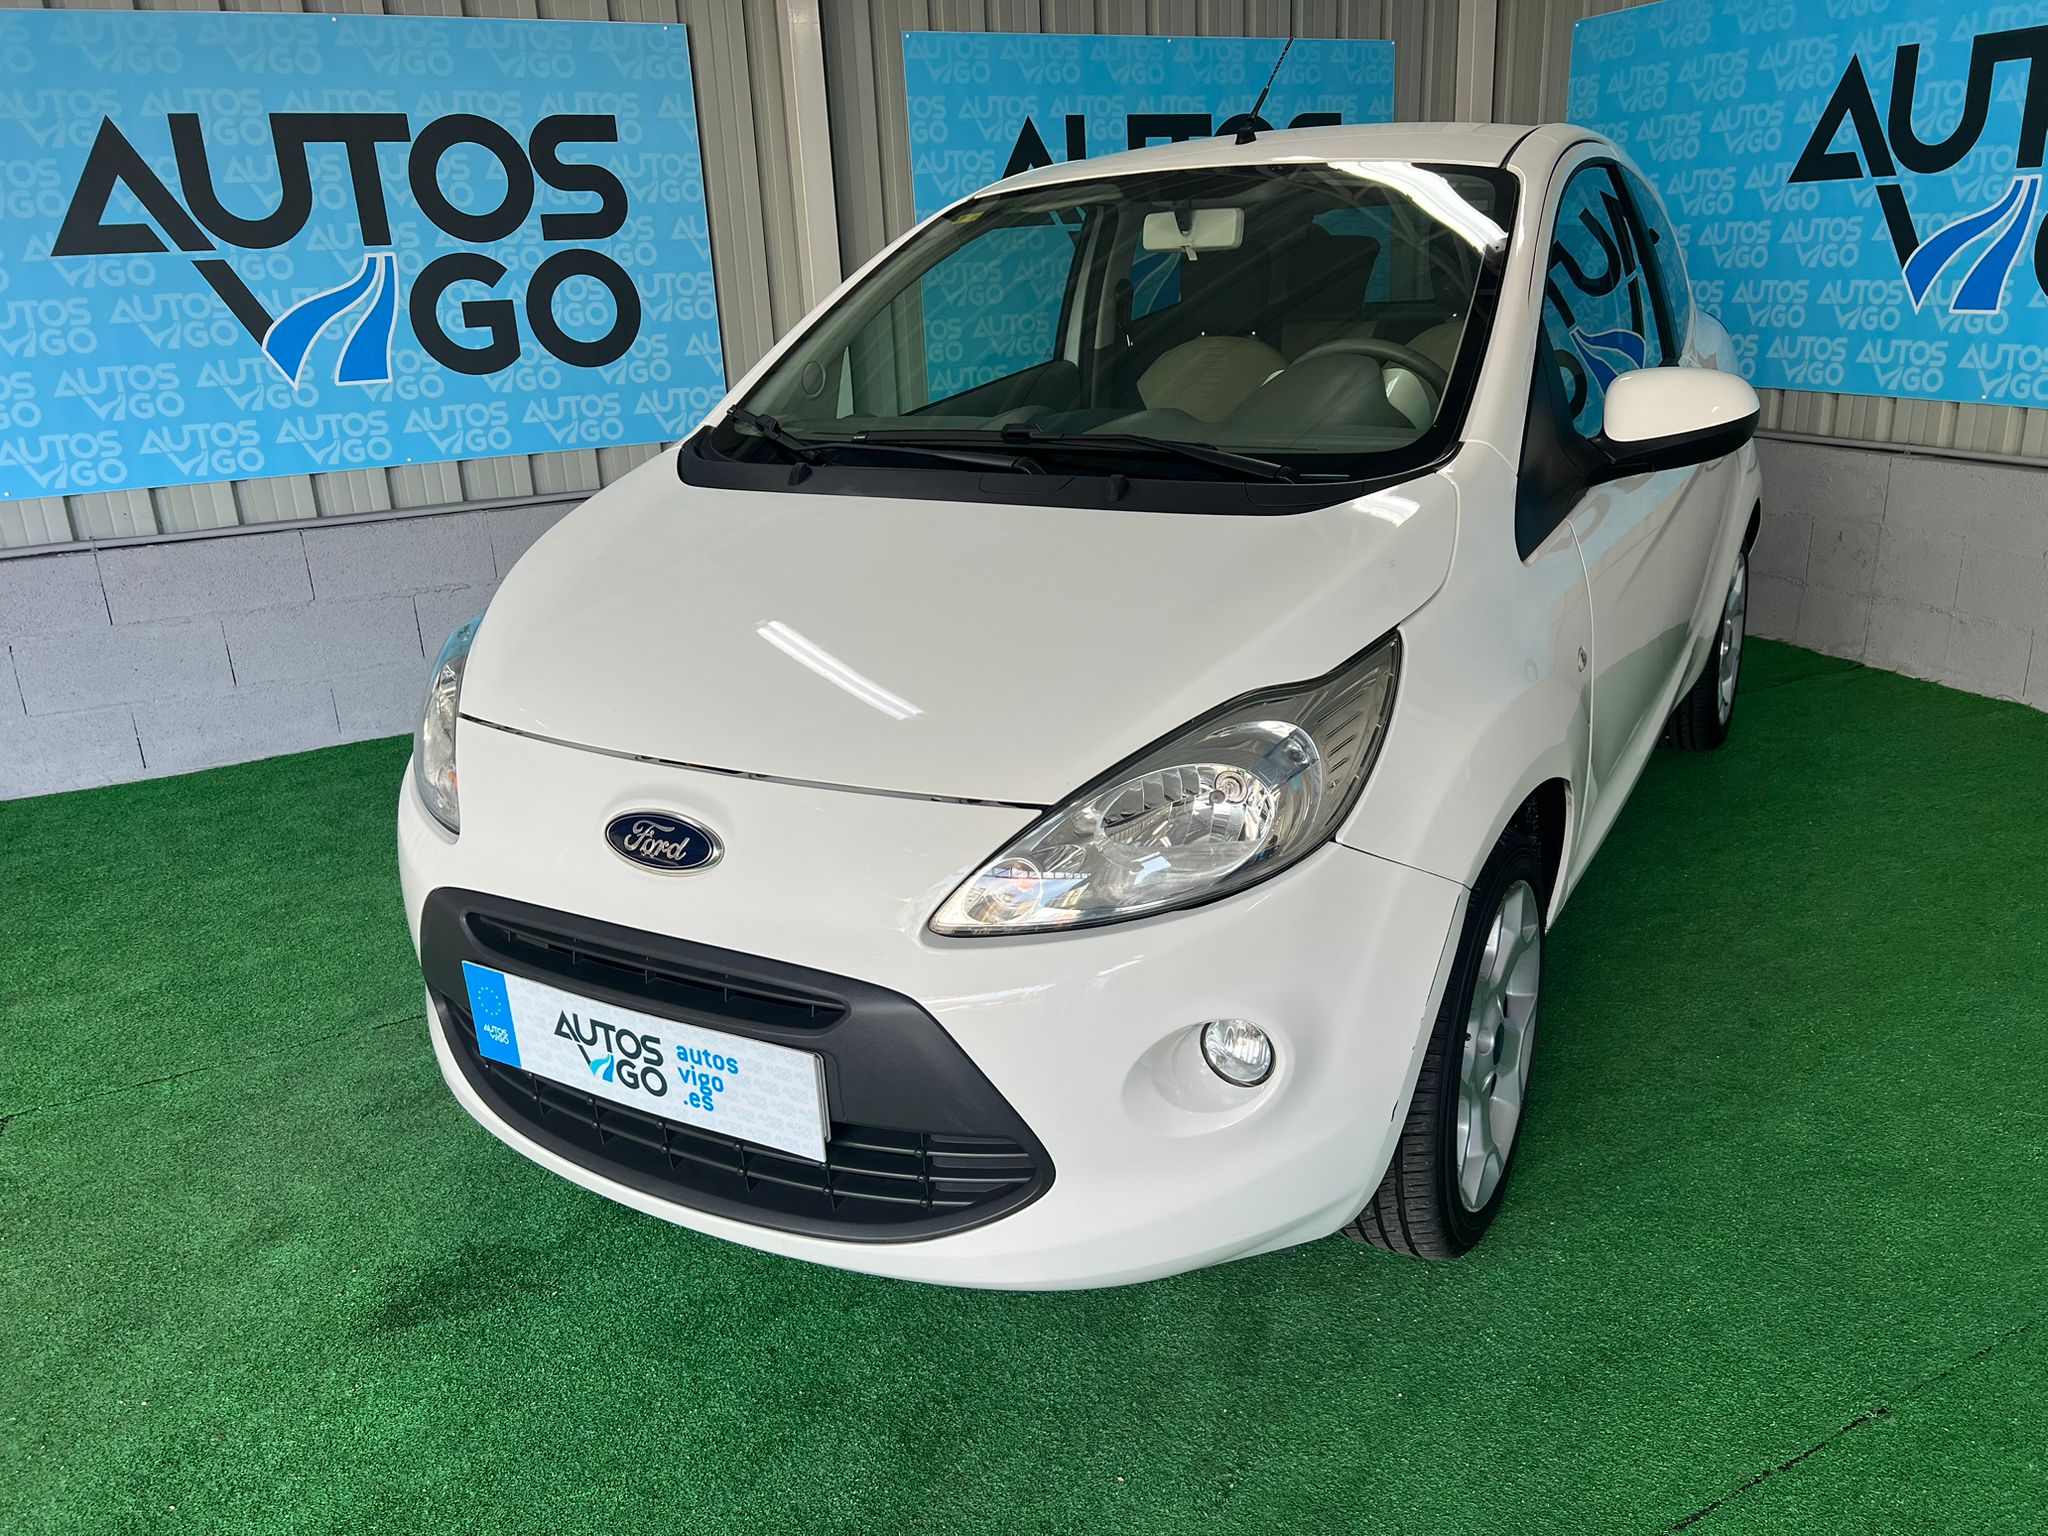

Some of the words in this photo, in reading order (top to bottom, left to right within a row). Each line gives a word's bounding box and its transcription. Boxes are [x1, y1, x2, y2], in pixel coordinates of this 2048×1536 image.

[49, 15, 178, 44] AUTOS
[197, 17, 320, 45] AUTOS
[335, 20, 449, 49] AUTOS
[465, 23, 572, 50] AUTOS
[587, 26, 684, 52] AUTOS
[77, 45, 183, 74] VIGO
[224, 46, 323, 75] VIGO
[362, 49, 454, 77] VIGO
[490, 50, 577, 79] VIGO
[606, 50, 689, 80] VIGO
[1676, 48, 1749, 84] AUTOS
[1756, 33, 1840, 71] AUTOS
[1606, 61, 1671, 95] AUTOS
[1690, 74, 1747, 104] VIGO
[1772, 60, 1836, 92] VIGO
[958, 95, 1041, 119] AUTOS
[1617, 87, 1669, 113] VIGO
[1636, 110, 1703, 142] AUTOS
[1710, 100, 1786, 134] AUTOS
[1648, 135, 1701, 162] VIGO
[1723, 126, 1783, 155] VIGO
[914, 151, 998, 175] AUTOS
[50, 112, 629, 257] AUTOS
[1665, 166, 1737, 196] AUTOS
[1680, 190, 1735, 217] VIGO
[1758, 185, 1822, 213] VIGO
[1697, 219, 1773, 246] AUTOS
[1779, 215, 1865, 244] AUTOS
[1711, 244, 1769, 269] VIGO
[1795, 243, 1860, 269] VIGO
[638, 272, 714, 300] UTOS
[1731, 278, 1810, 305] AUTOS
[1816, 279, 1904, 305] AUTOS
[0, 298, 92, 330] UTOS
[190, 247, 642, 387] VIGO
[1746, 303, 1807, 329] VIGO
[1833, 303, 1902, 332] VIGO
[134, 320, 240, 350] VIGO
[1766, 335, 1849, 362] AUTOS
[1855, 338, 1949, 368] AUTOS
[54, 363, 181, 398] AUTOS
[1781, 358, 1845, 386] VIGO
[1872, 363, 1945, 394] VIGO
[80, 391, 185, 421] VIGO
[402, 400, 509, 434] AUTOS
[522, 391, 621, 425] AUTOS
[140, 420, 261, 455] AUTOS
[275, 410, 390, 445] AUTOS
[543, 417, 625, 445] VIGO
[298, 436, 393, 466] VIGO
[424, 430, 513, 455] VIGO
[24, 457, 129, 489] VIGO
[163, 446, 265, 477] VIGO
[624, 820, 690, 860] Ford
[482, 1023, 510, 1039] AUTOS
[553, 1010, 664, 1067] AUTOS
[577, 1044, 668, 1097] VIGO
[675, 1044, 739, 1075] autos
[678, 1066, 725, 1098] vigo
[684, 1087, 715, 1112] .es
